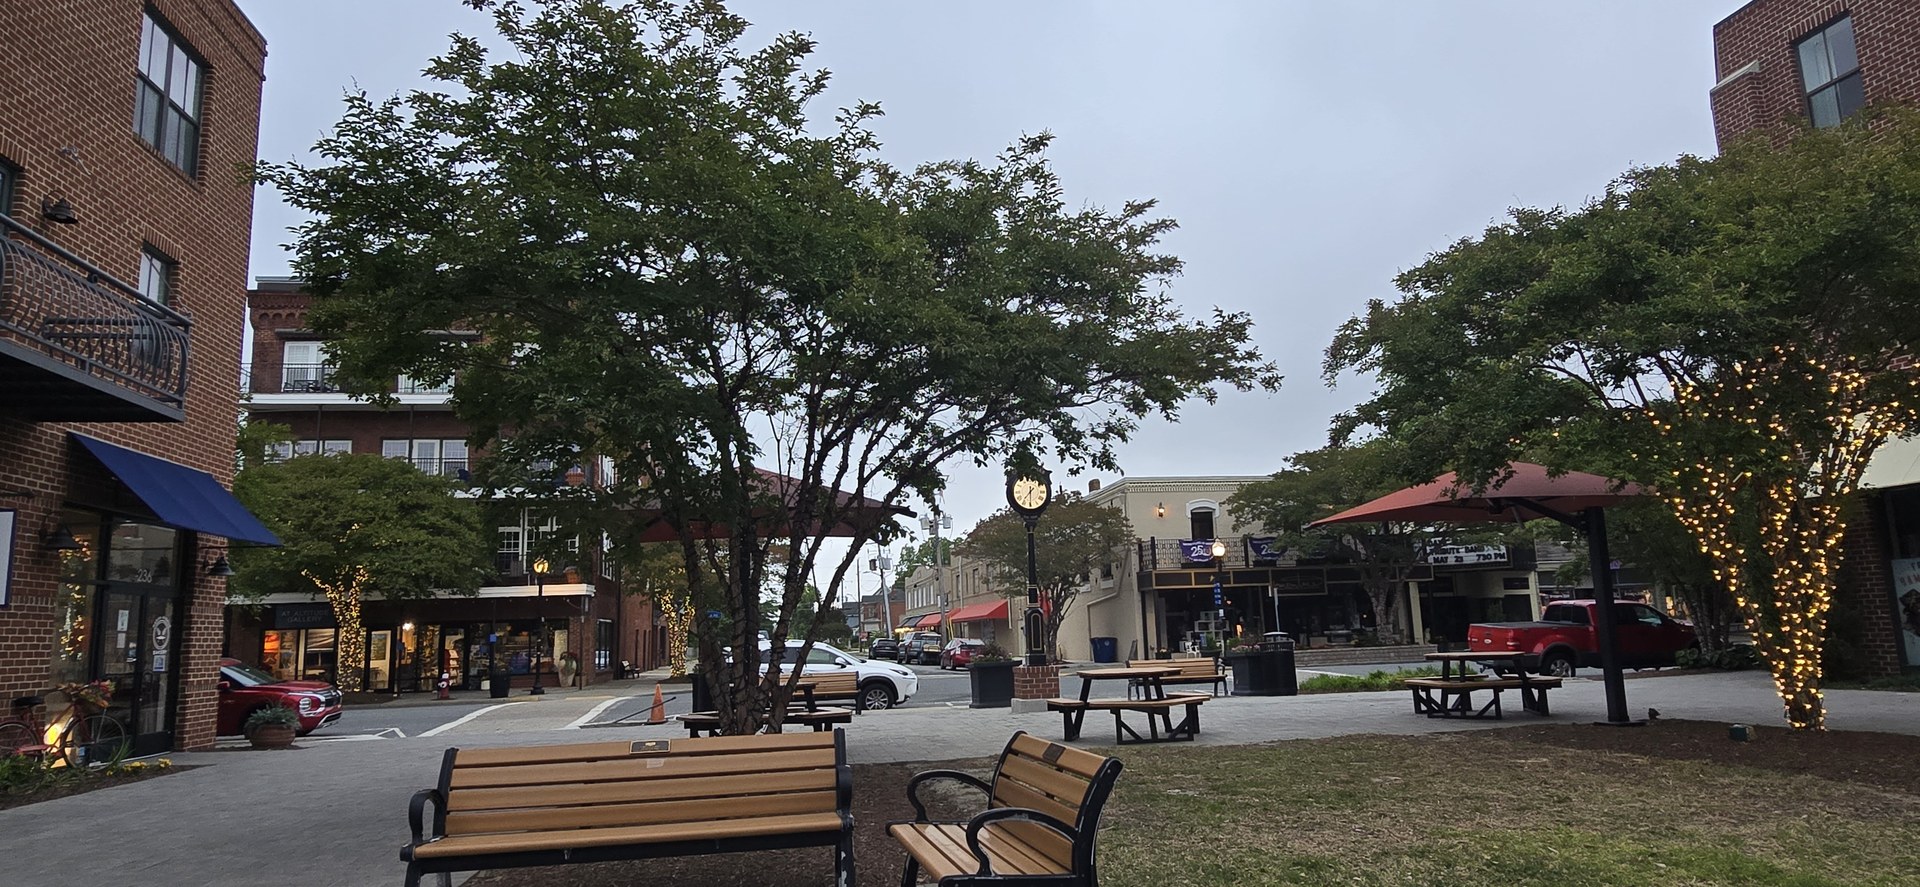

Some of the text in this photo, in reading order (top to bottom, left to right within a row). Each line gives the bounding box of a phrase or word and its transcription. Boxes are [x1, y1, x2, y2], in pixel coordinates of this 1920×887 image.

[1494, 552, 1506, 560] PM
[137, 568, 153, 584] 236
[287, 616, 322, 624] GALLERY
